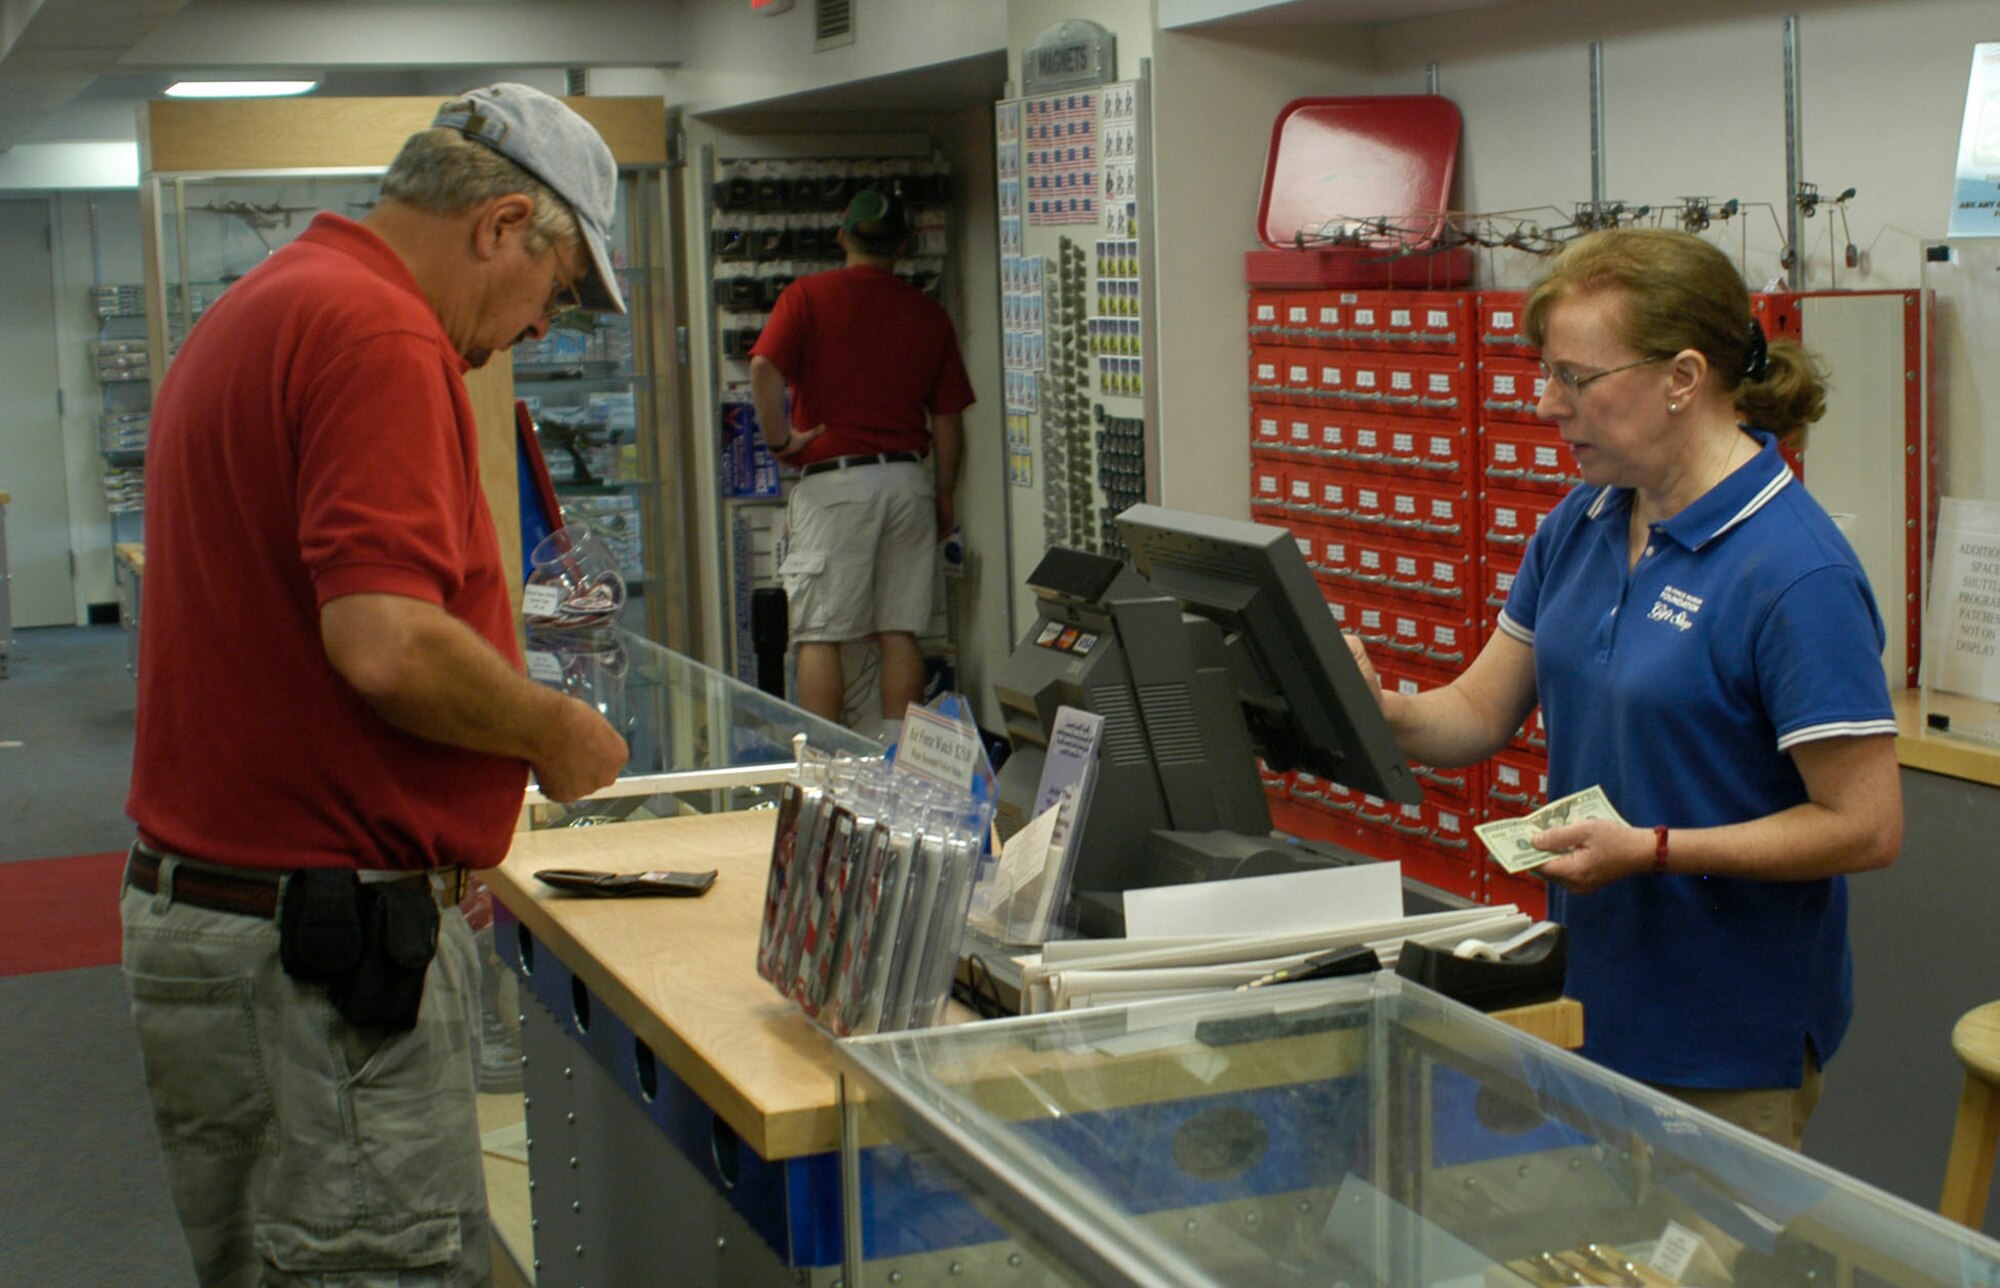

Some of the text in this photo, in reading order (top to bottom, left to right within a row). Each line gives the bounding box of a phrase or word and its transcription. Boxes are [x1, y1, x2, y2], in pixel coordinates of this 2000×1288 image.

[1038, 46, 1087, 76] MAGNETS
[1960, 624, 1996, 640] NOT ON
[1956, 639, 1997, 656] DISPLAY
